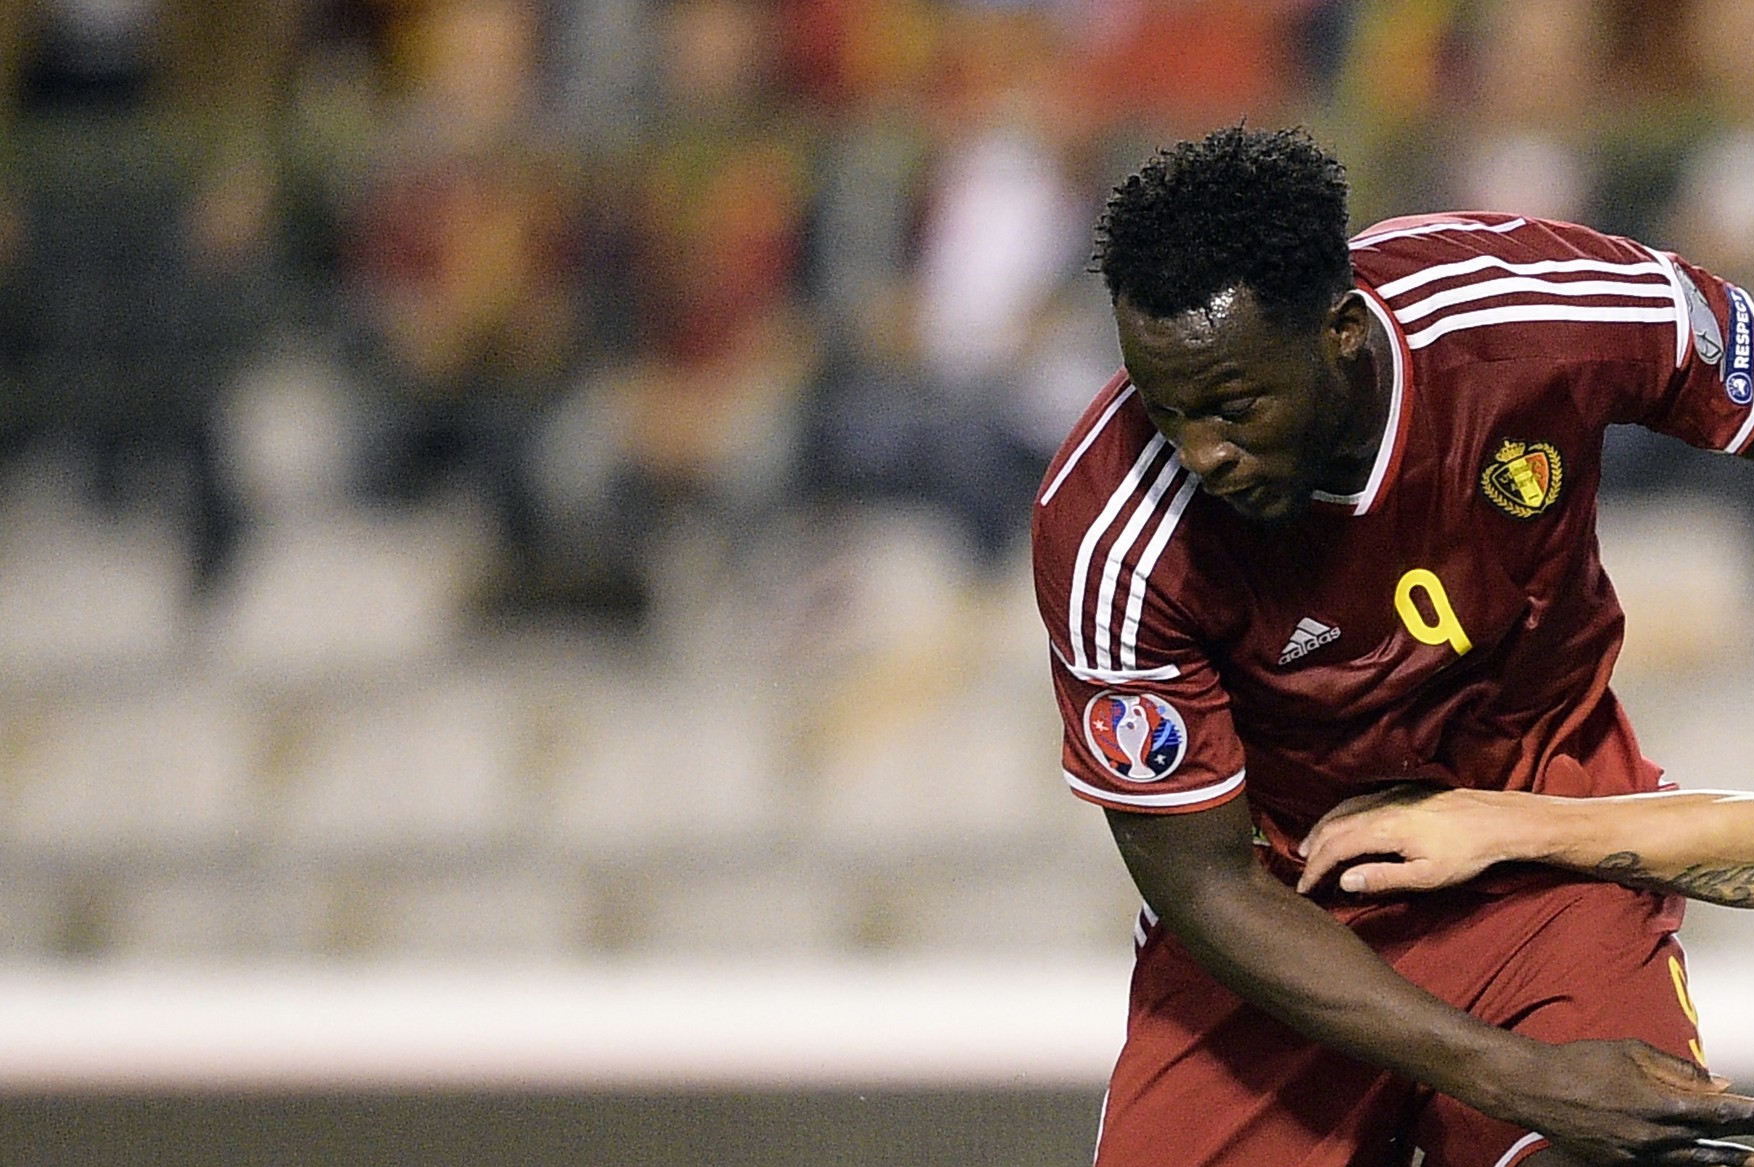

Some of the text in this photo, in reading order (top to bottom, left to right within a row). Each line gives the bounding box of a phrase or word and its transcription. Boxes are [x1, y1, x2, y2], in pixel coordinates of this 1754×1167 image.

[1731, 290, 1750, 369] RESPECT
[1278, 626, 1342, 665] adidas
[1394, 568, 1473, 656] 9
